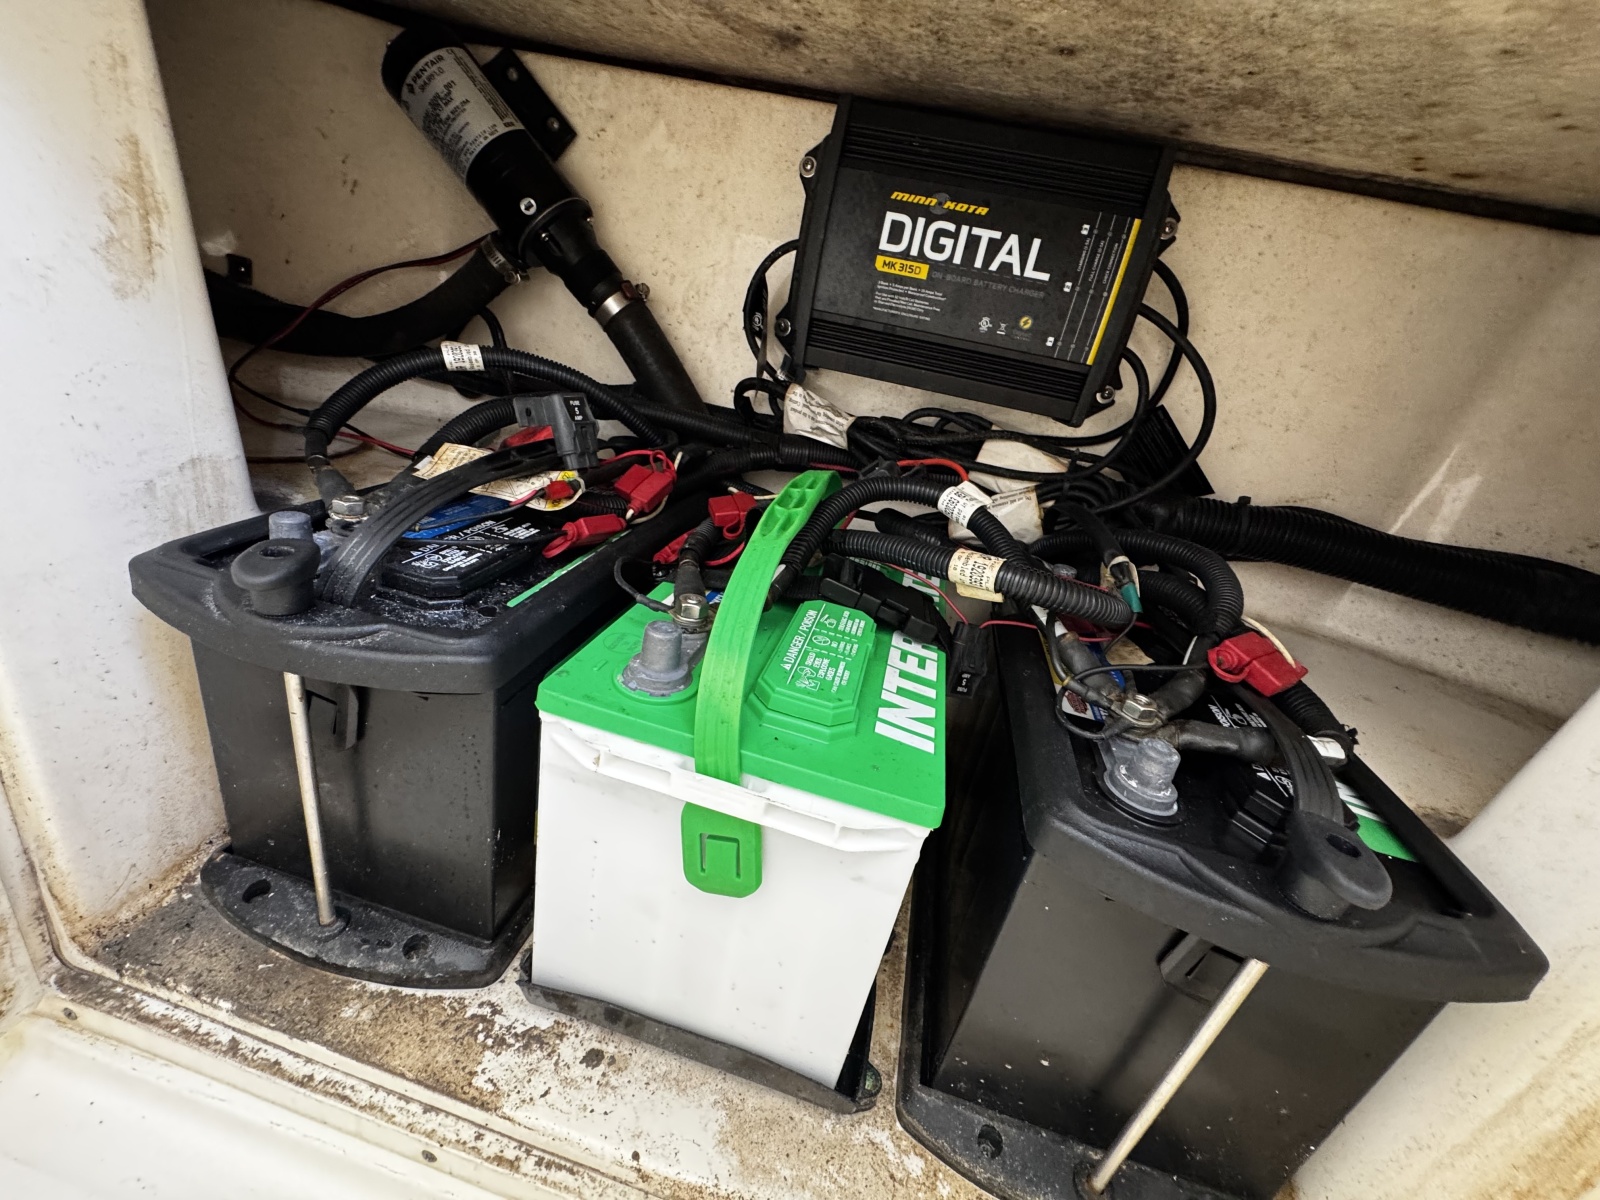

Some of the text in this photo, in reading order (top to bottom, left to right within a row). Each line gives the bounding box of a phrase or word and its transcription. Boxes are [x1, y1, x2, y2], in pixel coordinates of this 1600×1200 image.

[412, 54, 444, 84] PENTAIR
[891, 191, 989, 216] MINN KOTA
[878, 211, 1050, 281] DIGITAL
[882, 259, 922, 275] MK 315D
[974, 279, 1007, 292] BATTERY
[1008, 285, 1046, 300] CHARGER
[783, 635, 805, 663] DANGER
[799, 610, 818, 631] POISON
[825, 667, 836, 680] GASES
